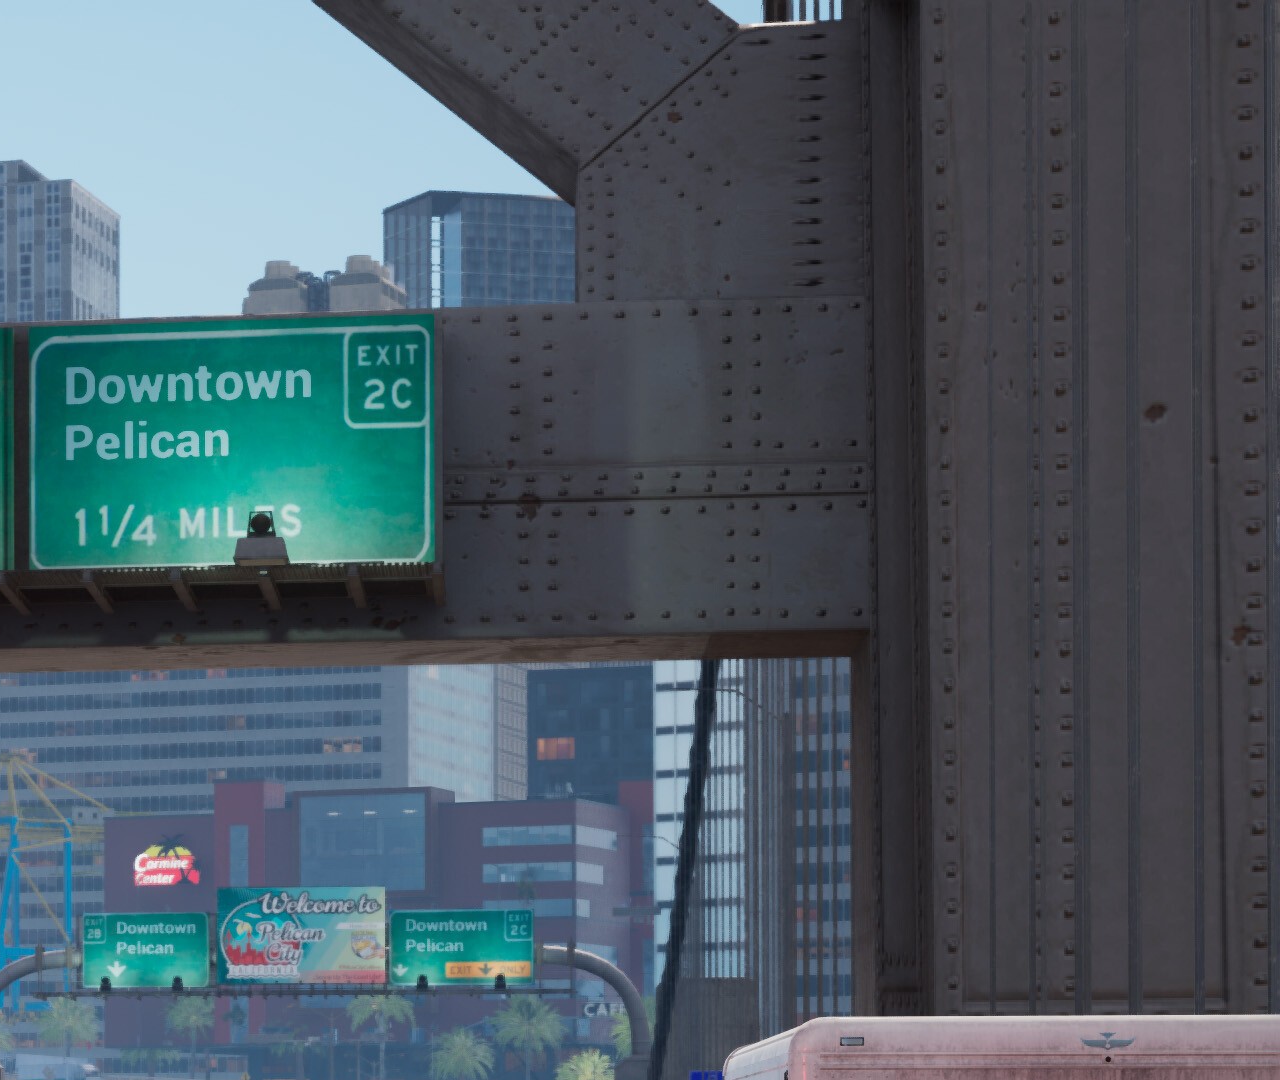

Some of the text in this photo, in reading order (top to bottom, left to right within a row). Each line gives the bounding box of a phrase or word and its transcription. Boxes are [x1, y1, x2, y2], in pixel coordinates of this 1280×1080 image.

[357, 344, 419, 367] EXIT
[65, 365, 312, 405] Downtown
[364, 378, 412, 410] 2C
[65, 420, 229, 461] Pelican
[179, 503, 302, 540] MILS
[257, 890, 382, 914] Welcome to
[116, 921, 196, 935] Downtown
[256, 921, 325, 942] Pelican
[405, 918, 488, 932] Downtown
[116, 941, 174, 955] Pelican
[267, 941, 303, 965] City
[405, 938, 464, 952] Pelican
[232, 965, 295, 976] CALIFORNIA
